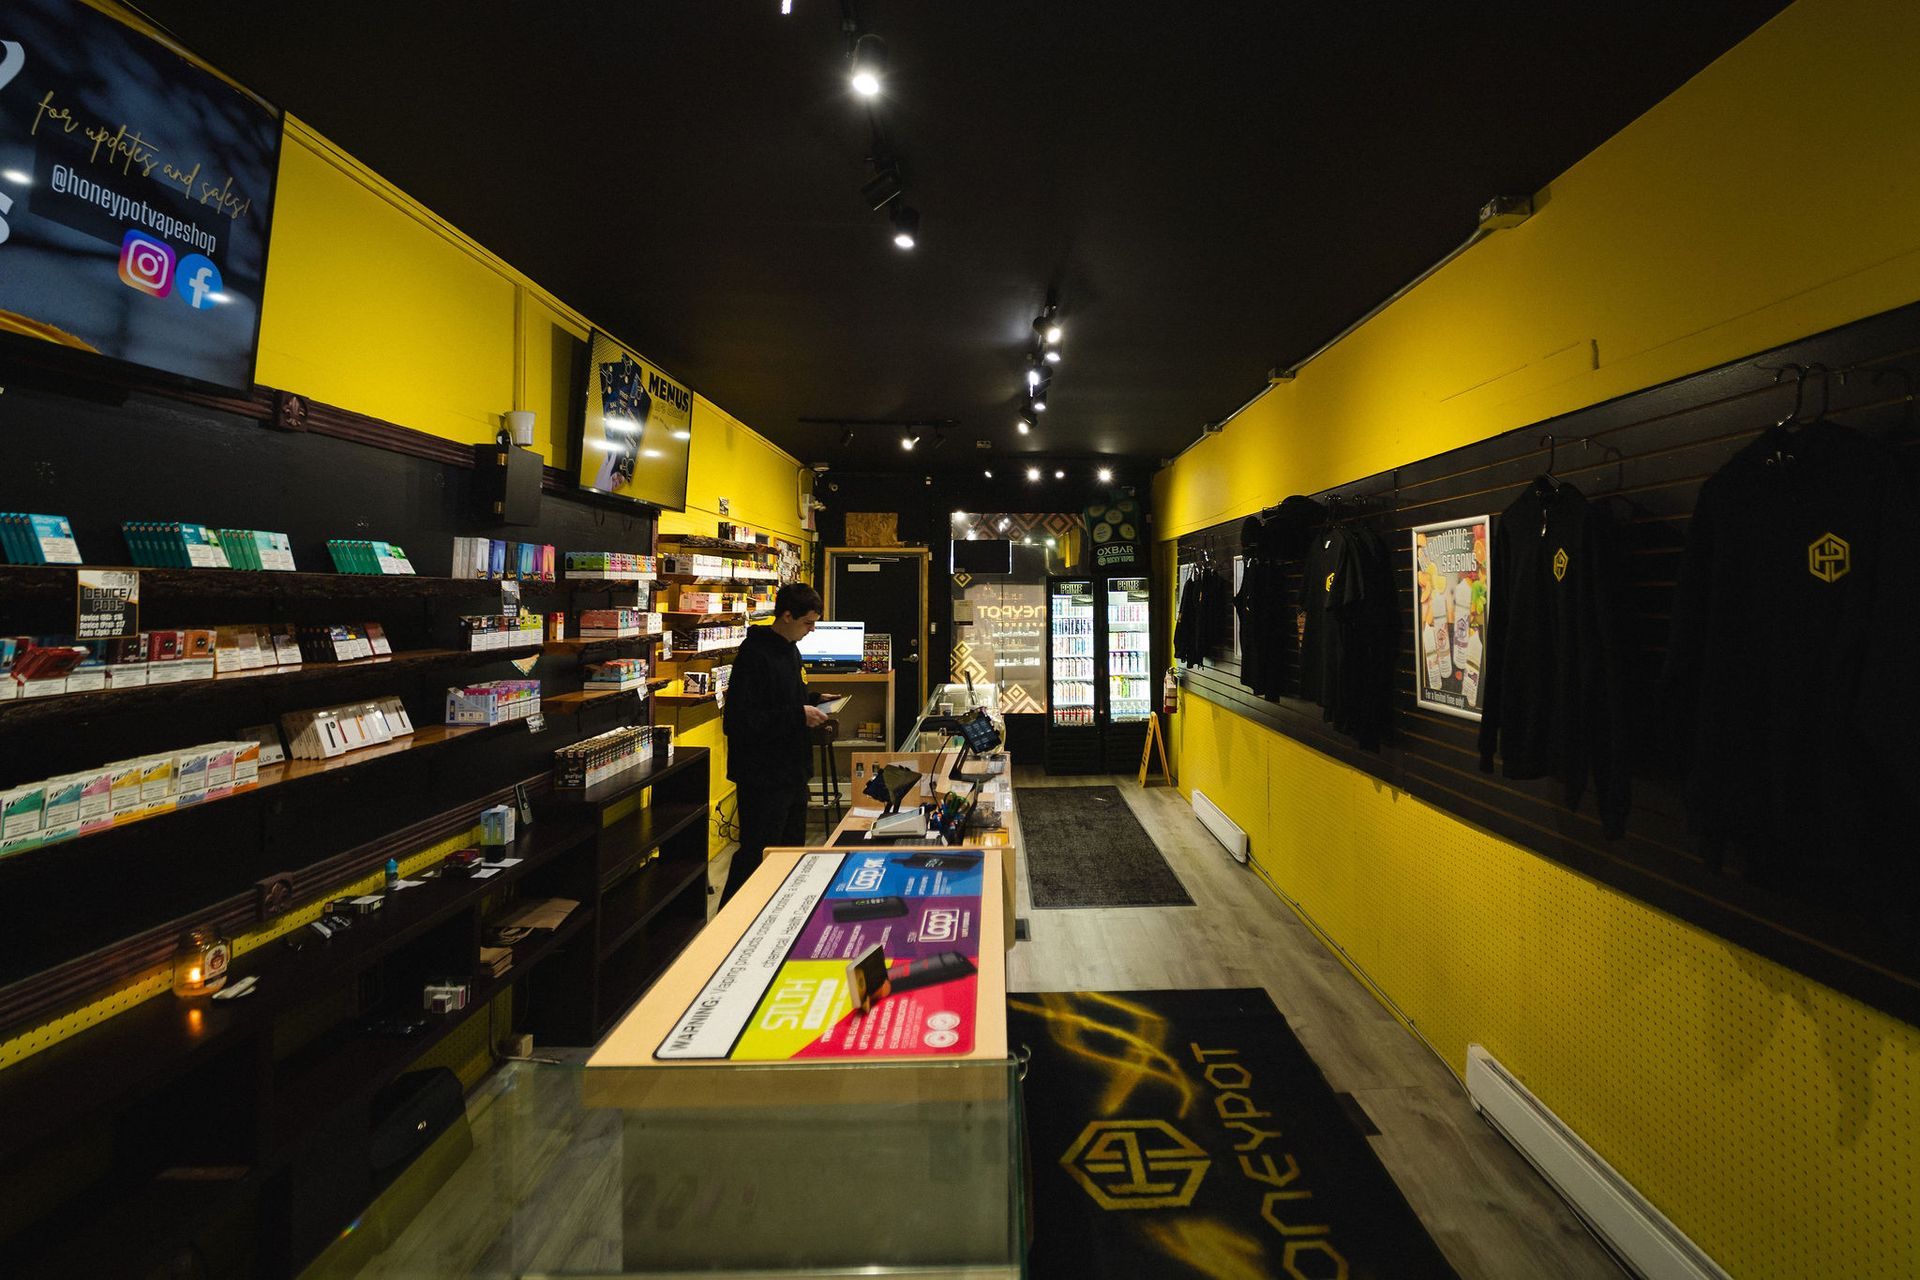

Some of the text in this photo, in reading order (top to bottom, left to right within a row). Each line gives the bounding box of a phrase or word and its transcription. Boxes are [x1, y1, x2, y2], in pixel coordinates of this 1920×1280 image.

[85, 124, 160, 177] updates
[164, 163, 201, 199] and
[200, 177, 251, 220] sales!
[51, 165, 217, 256] @honeypotvapeshop
[648, 371, 690, 412] MENUS
[1097, 545, 1134, 556] OXBAR
[1442, 552, 1477, 573] SEASONS
[1060, 583, 1083, 594] PRIME
[1117, 580, 1140, 591] PRIME
[784, 915, 800, 935] Health
[794, 894, 817, 914] Canada
[668, 995, 722, 1051] WARNING:
[713, 966, 746, 994] Vaping
[734, 936, 764, 965] products
[756, 914, 778, 936] contain
[760, 979, 817, 1030] STLTH
